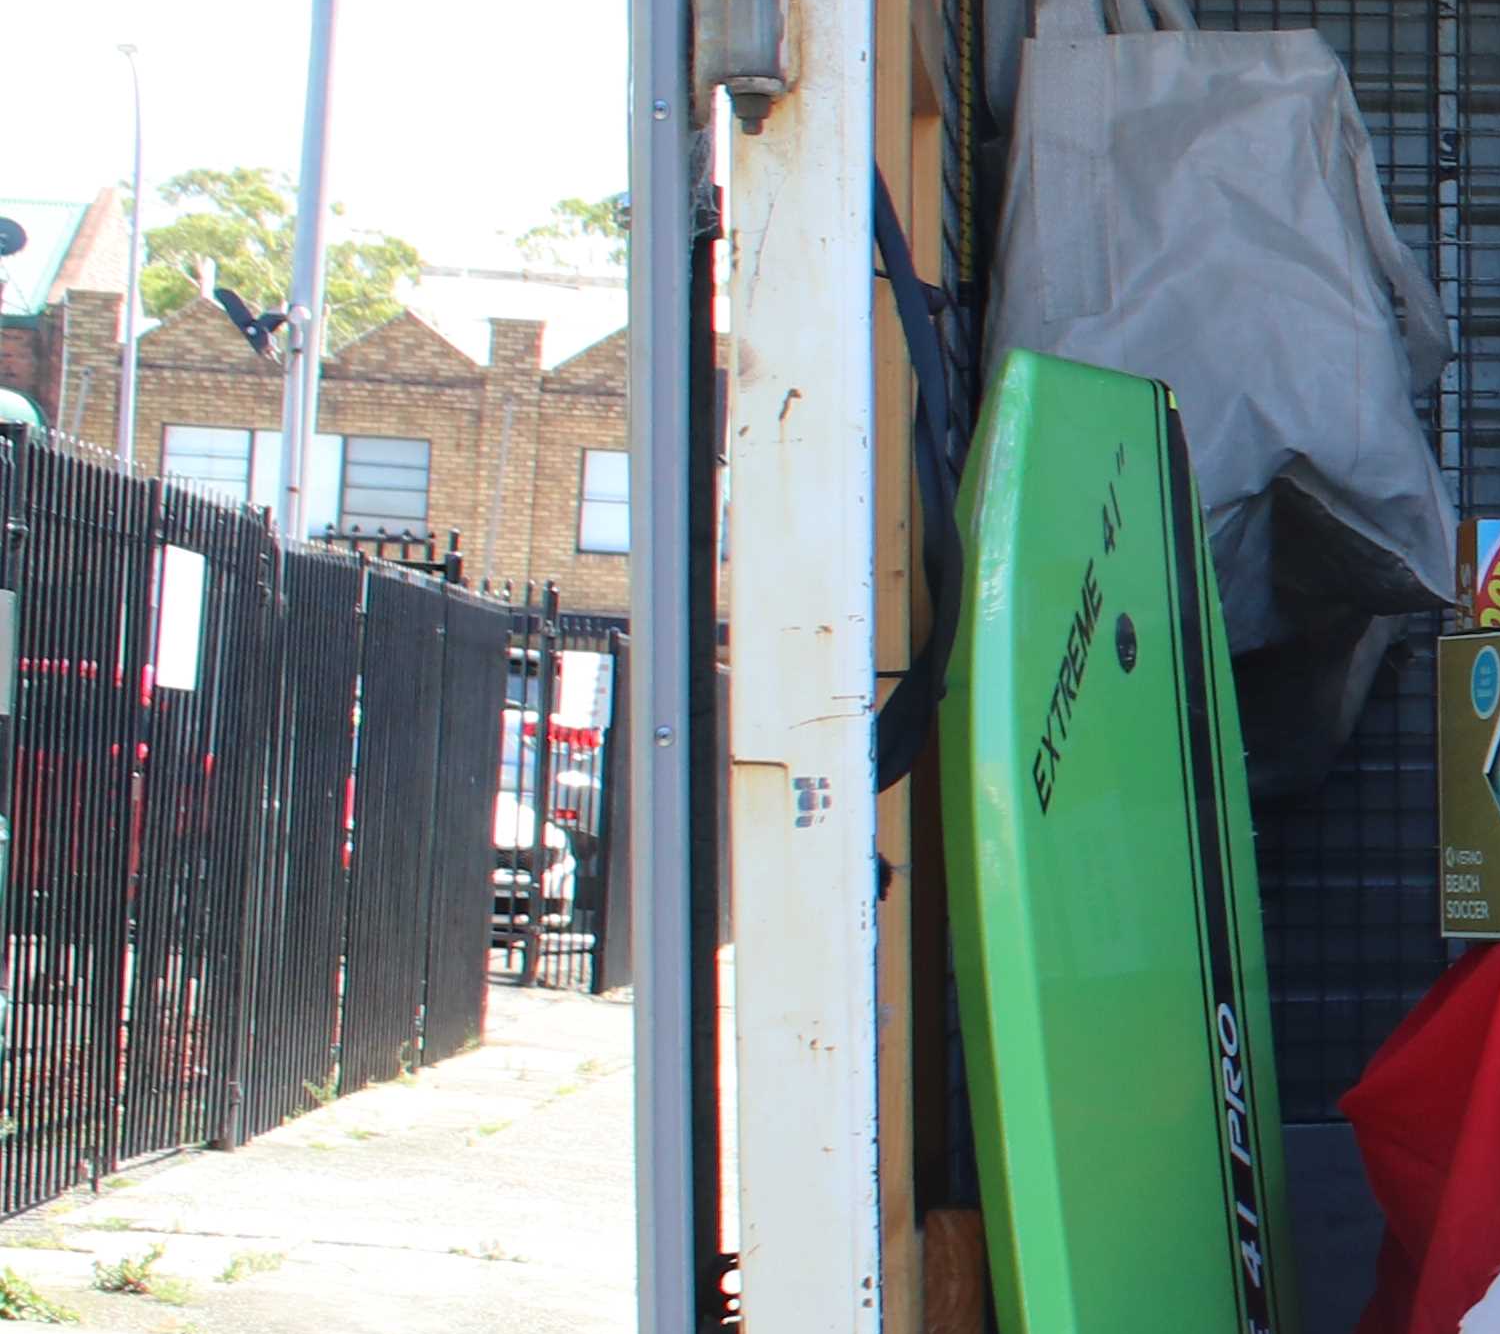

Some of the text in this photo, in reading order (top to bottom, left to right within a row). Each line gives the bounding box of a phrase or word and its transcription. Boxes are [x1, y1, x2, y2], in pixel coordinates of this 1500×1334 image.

[1032, 557, 1103, 816] EXTREME
[1445, 875, 1481, 893] BEACH
[1446, 900, 1489, 919] SOCCER
[1216, 1002, 1252, 1166] PRO
